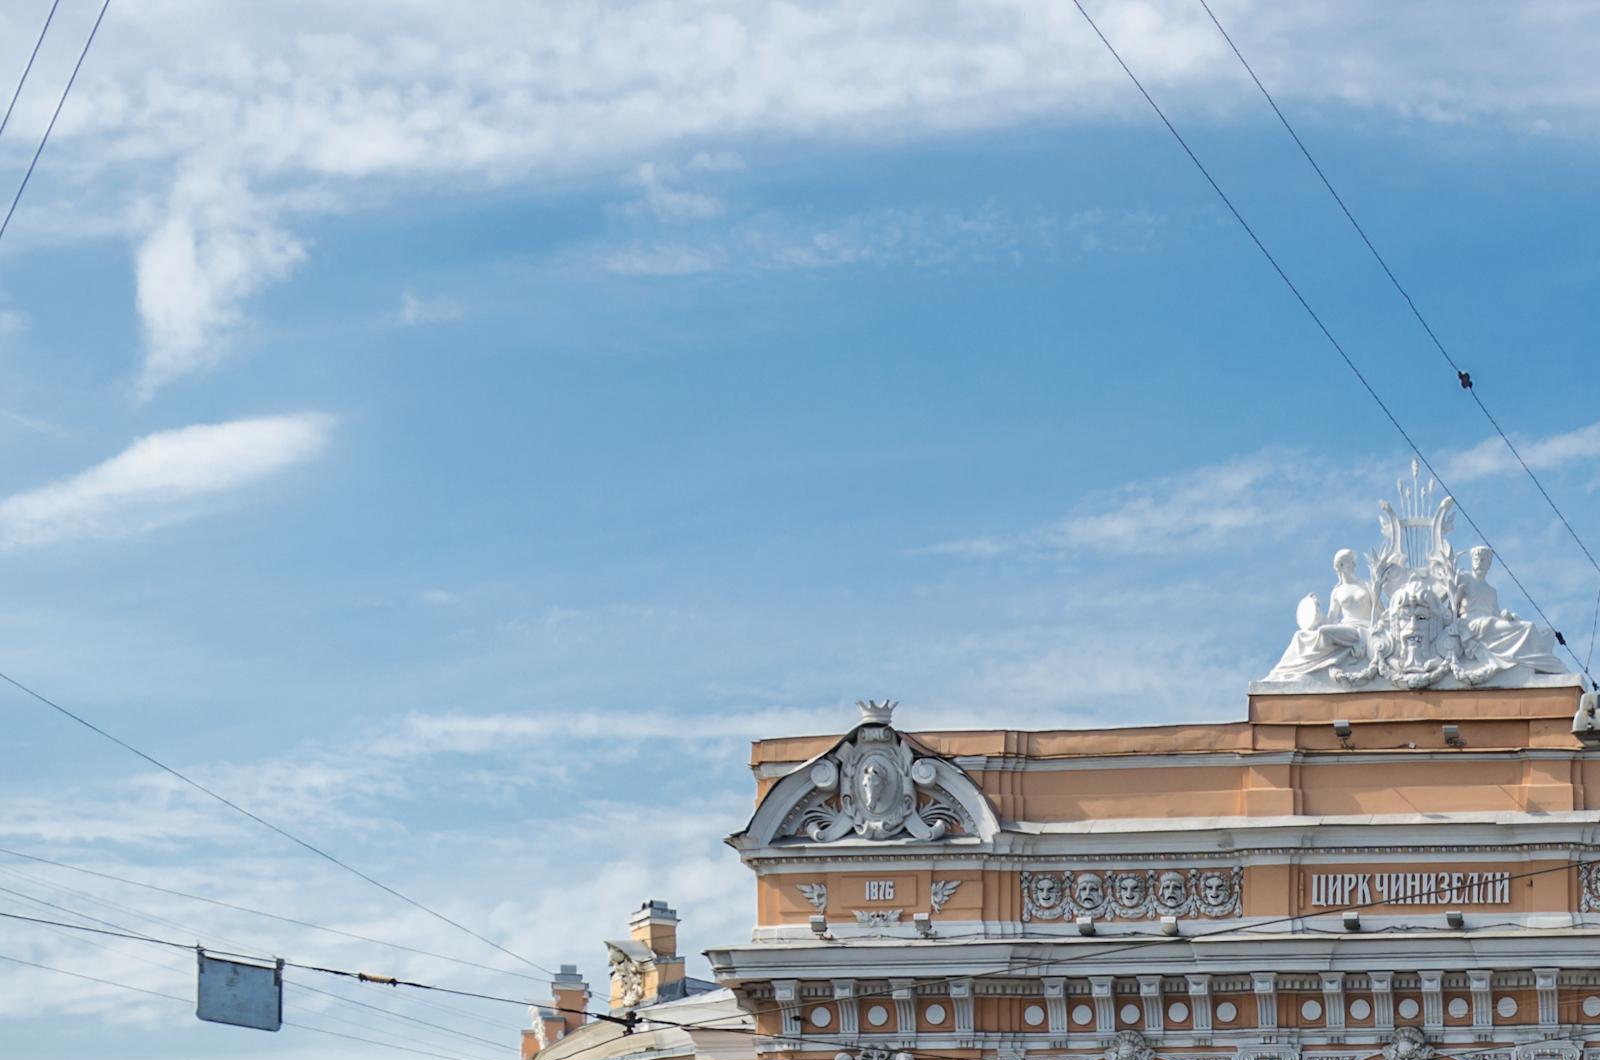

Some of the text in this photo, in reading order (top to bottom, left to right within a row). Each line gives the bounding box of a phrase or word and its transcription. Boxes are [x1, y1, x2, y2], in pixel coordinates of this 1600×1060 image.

[865, 880, 894, 900] 1876
[1312, 871, 1511, 907] ЦИРК ЧИНИЗЕЛЛИ
